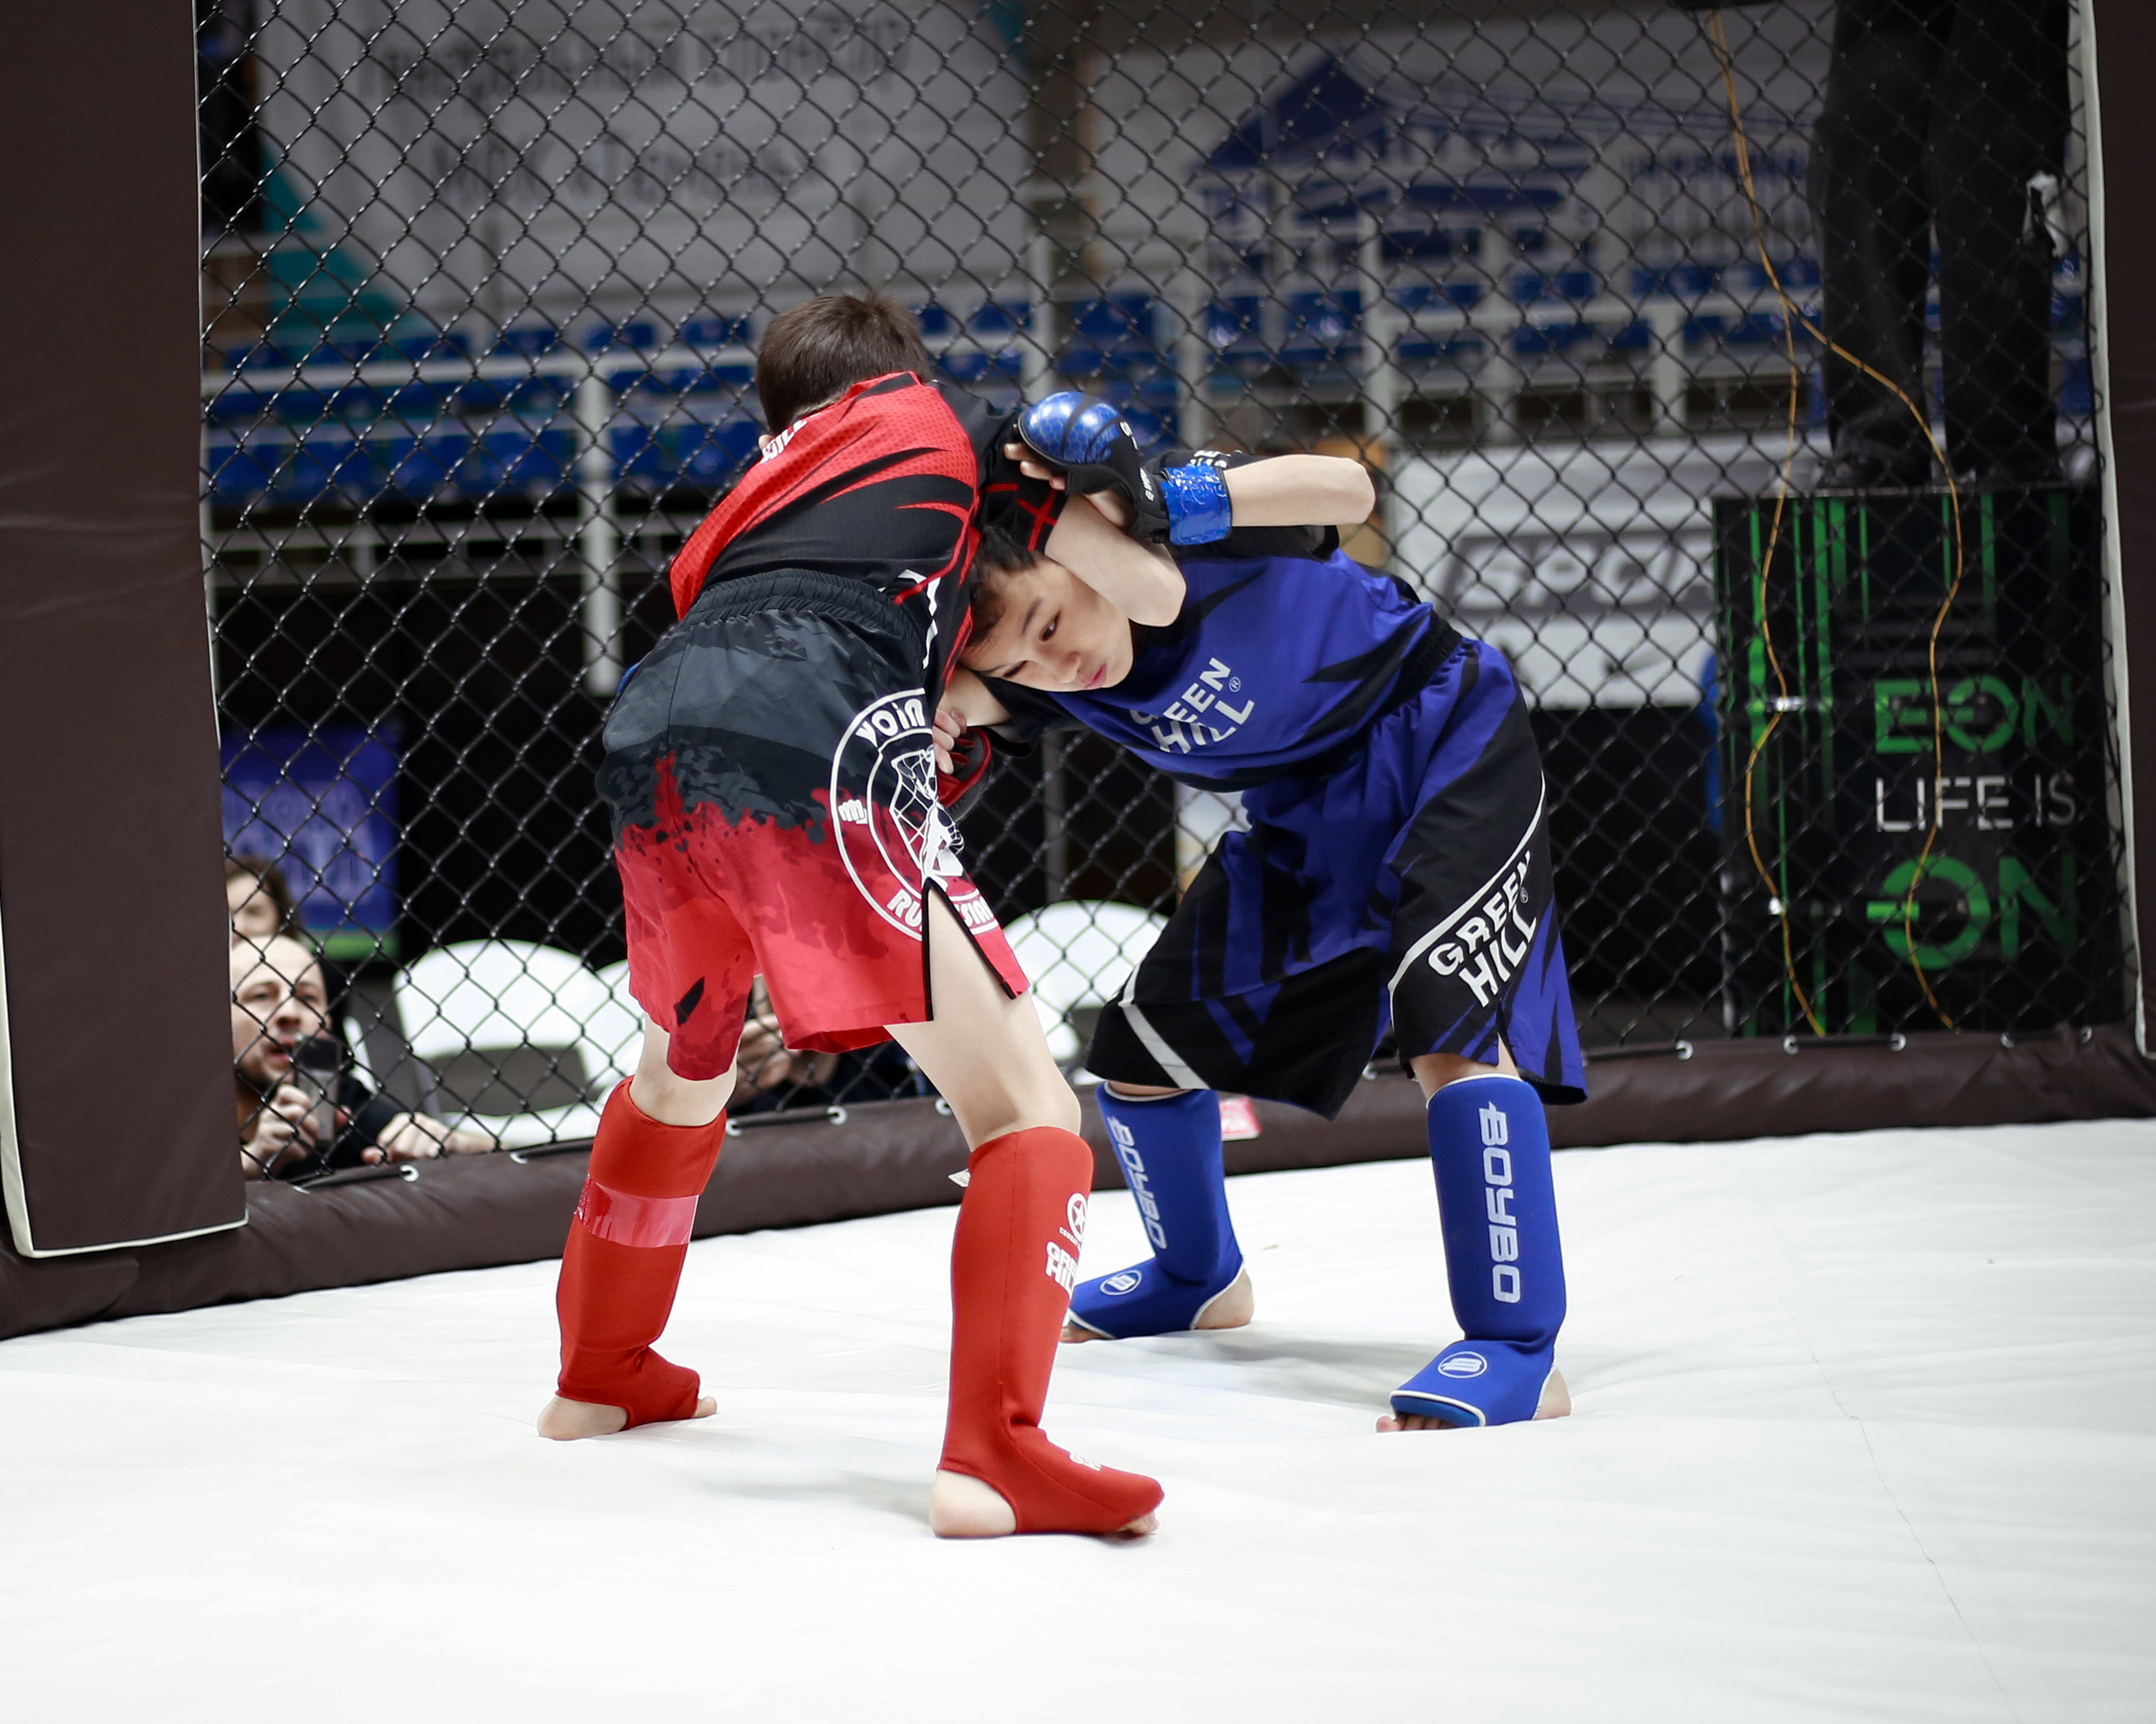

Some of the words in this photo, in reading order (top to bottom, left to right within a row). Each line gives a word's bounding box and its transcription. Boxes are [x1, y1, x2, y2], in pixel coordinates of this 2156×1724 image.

[1150, 700, 1255, 754] HILL
[1875, 775, 2014, 832] LIFE
[2036, 773, 2076, 827] IS
[1428, 850, 1531, 976] GREEN
[1458, 905, 1537, 1008] HILL
[1107, 1116, 1167, 1250] BOYBO
[1479, 1101, 1522, 1305] BOYBO
[1045, 1255, 1075, 1300] HIL
[1046, 1241, 1078, 1278] GRE
